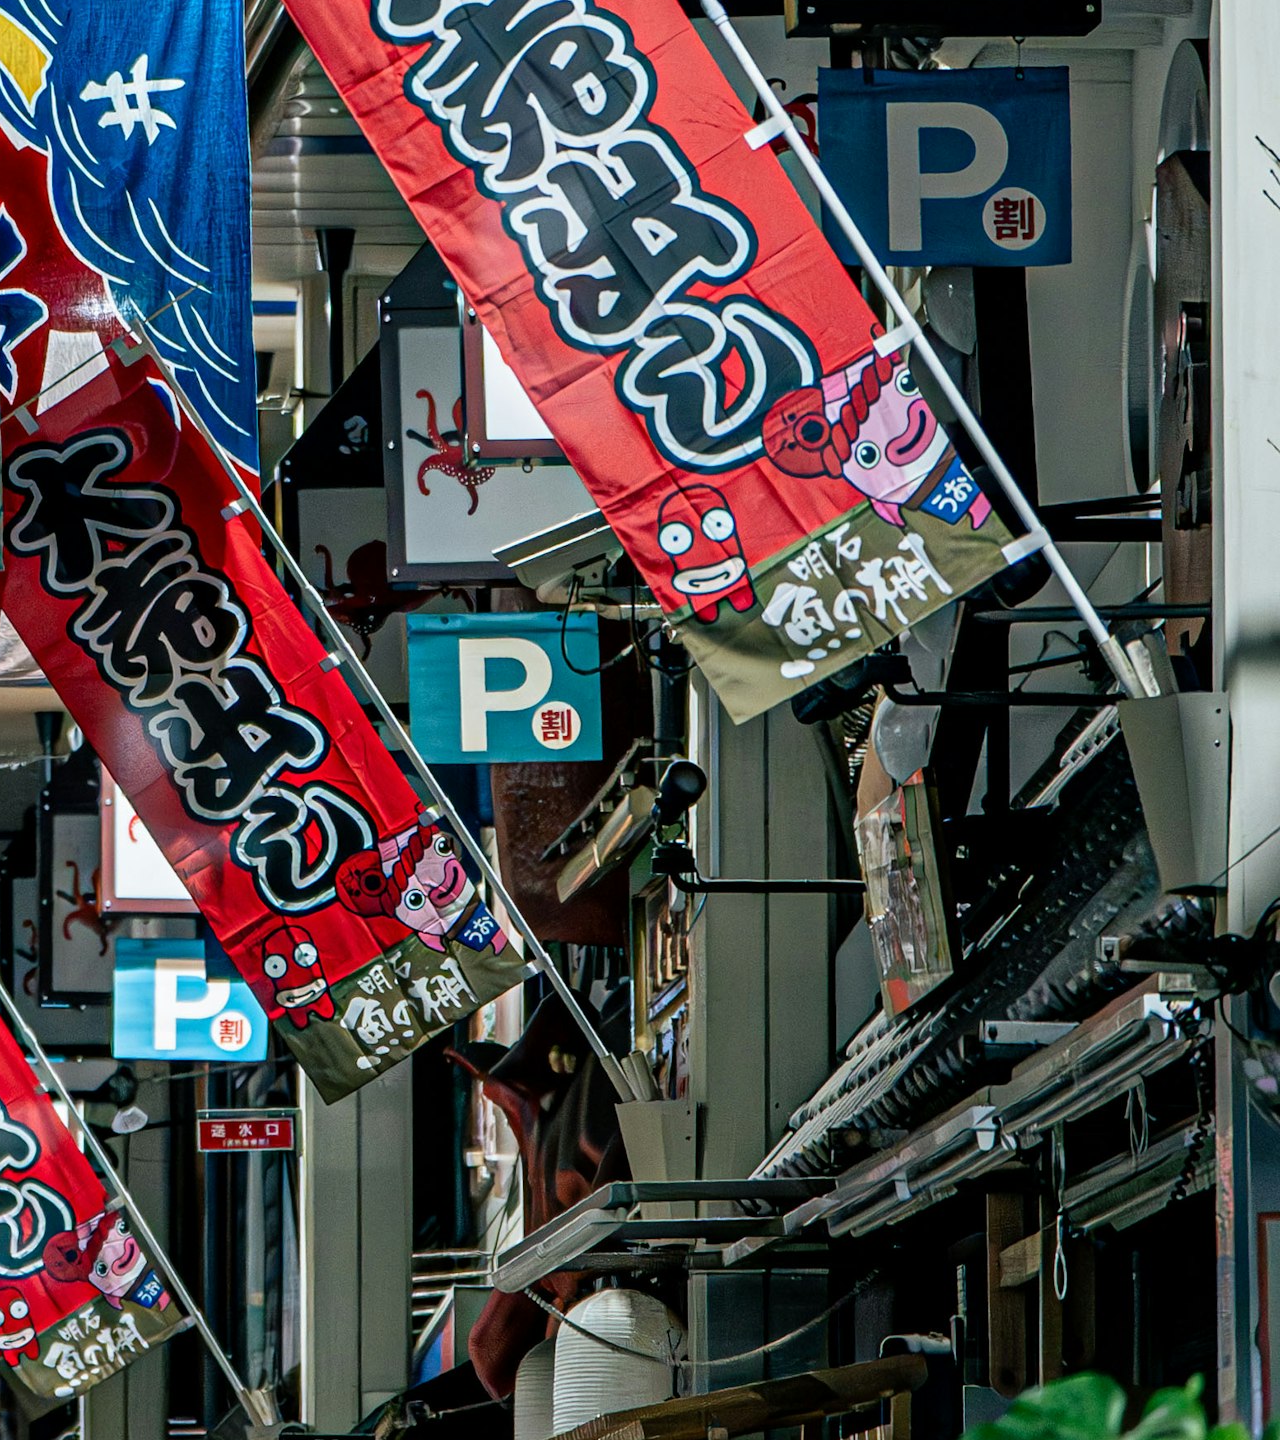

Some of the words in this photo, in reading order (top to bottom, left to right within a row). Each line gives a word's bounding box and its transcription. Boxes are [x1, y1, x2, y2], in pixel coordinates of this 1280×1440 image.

[885, 100, 1010, 252] P
[992, 195, 1039, 244] 割
[786, 522, 866, 586] 明石
[759, 530, 954, 679] 魚の棚
[5, 425, 378, 916] 大売出し
[458, 638, 550, 753] P
[540, 706, 574, 746] 割
[152, 957, 230, 1051] P
[338, 957, 481, 1071] 魚の棚
[359, 950, 411, 999] 明石
[216, 1016, 247, 1050] 割
[42, 1310, 152, 1401] 魚の棚
[57, 1303, 106, 1343] 明石
